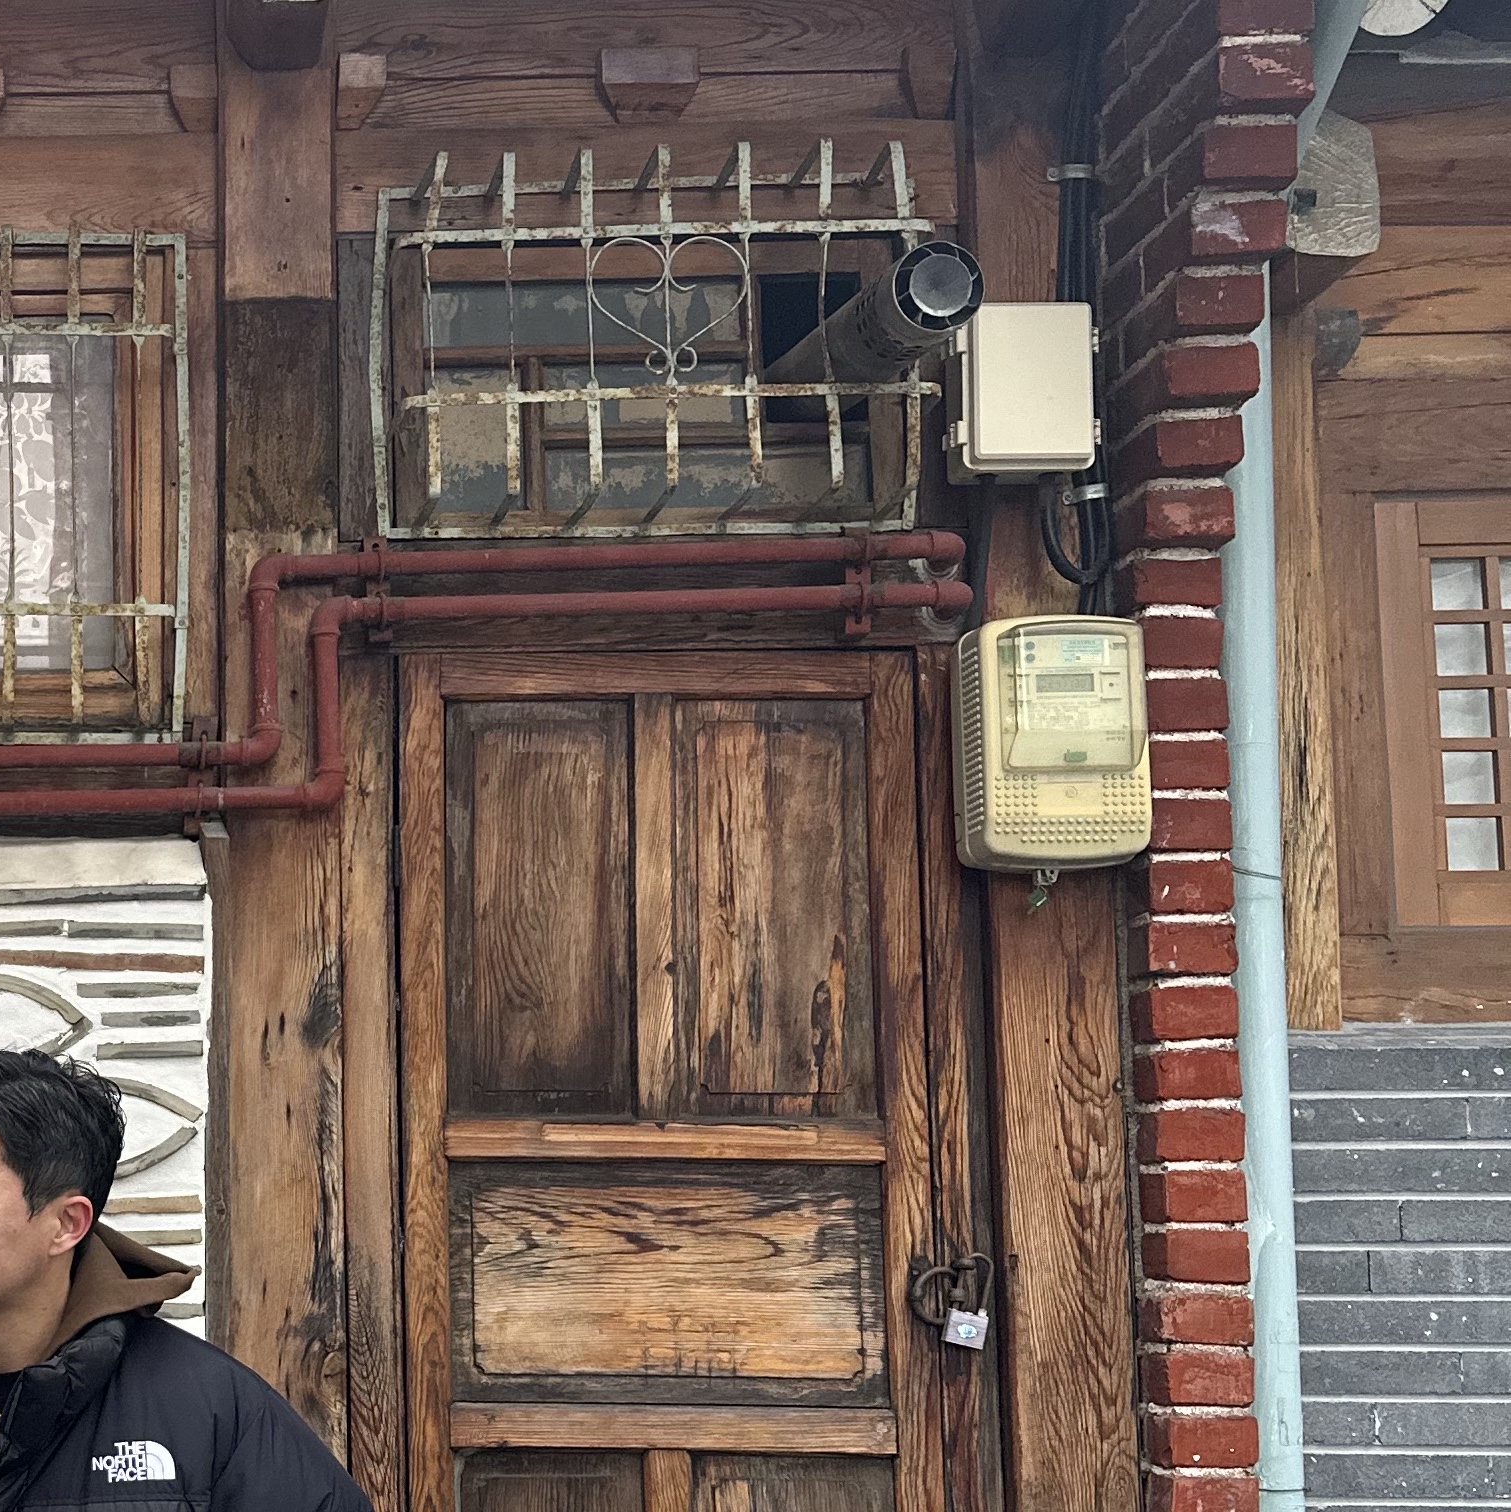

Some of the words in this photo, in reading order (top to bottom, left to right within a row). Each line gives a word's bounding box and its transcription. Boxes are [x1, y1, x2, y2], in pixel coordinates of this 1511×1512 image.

[113, 1440, 146, 1456] THE
[91, 1454, 147, 1471] NORTH
[108, 1467, 148, 1483] FACE
